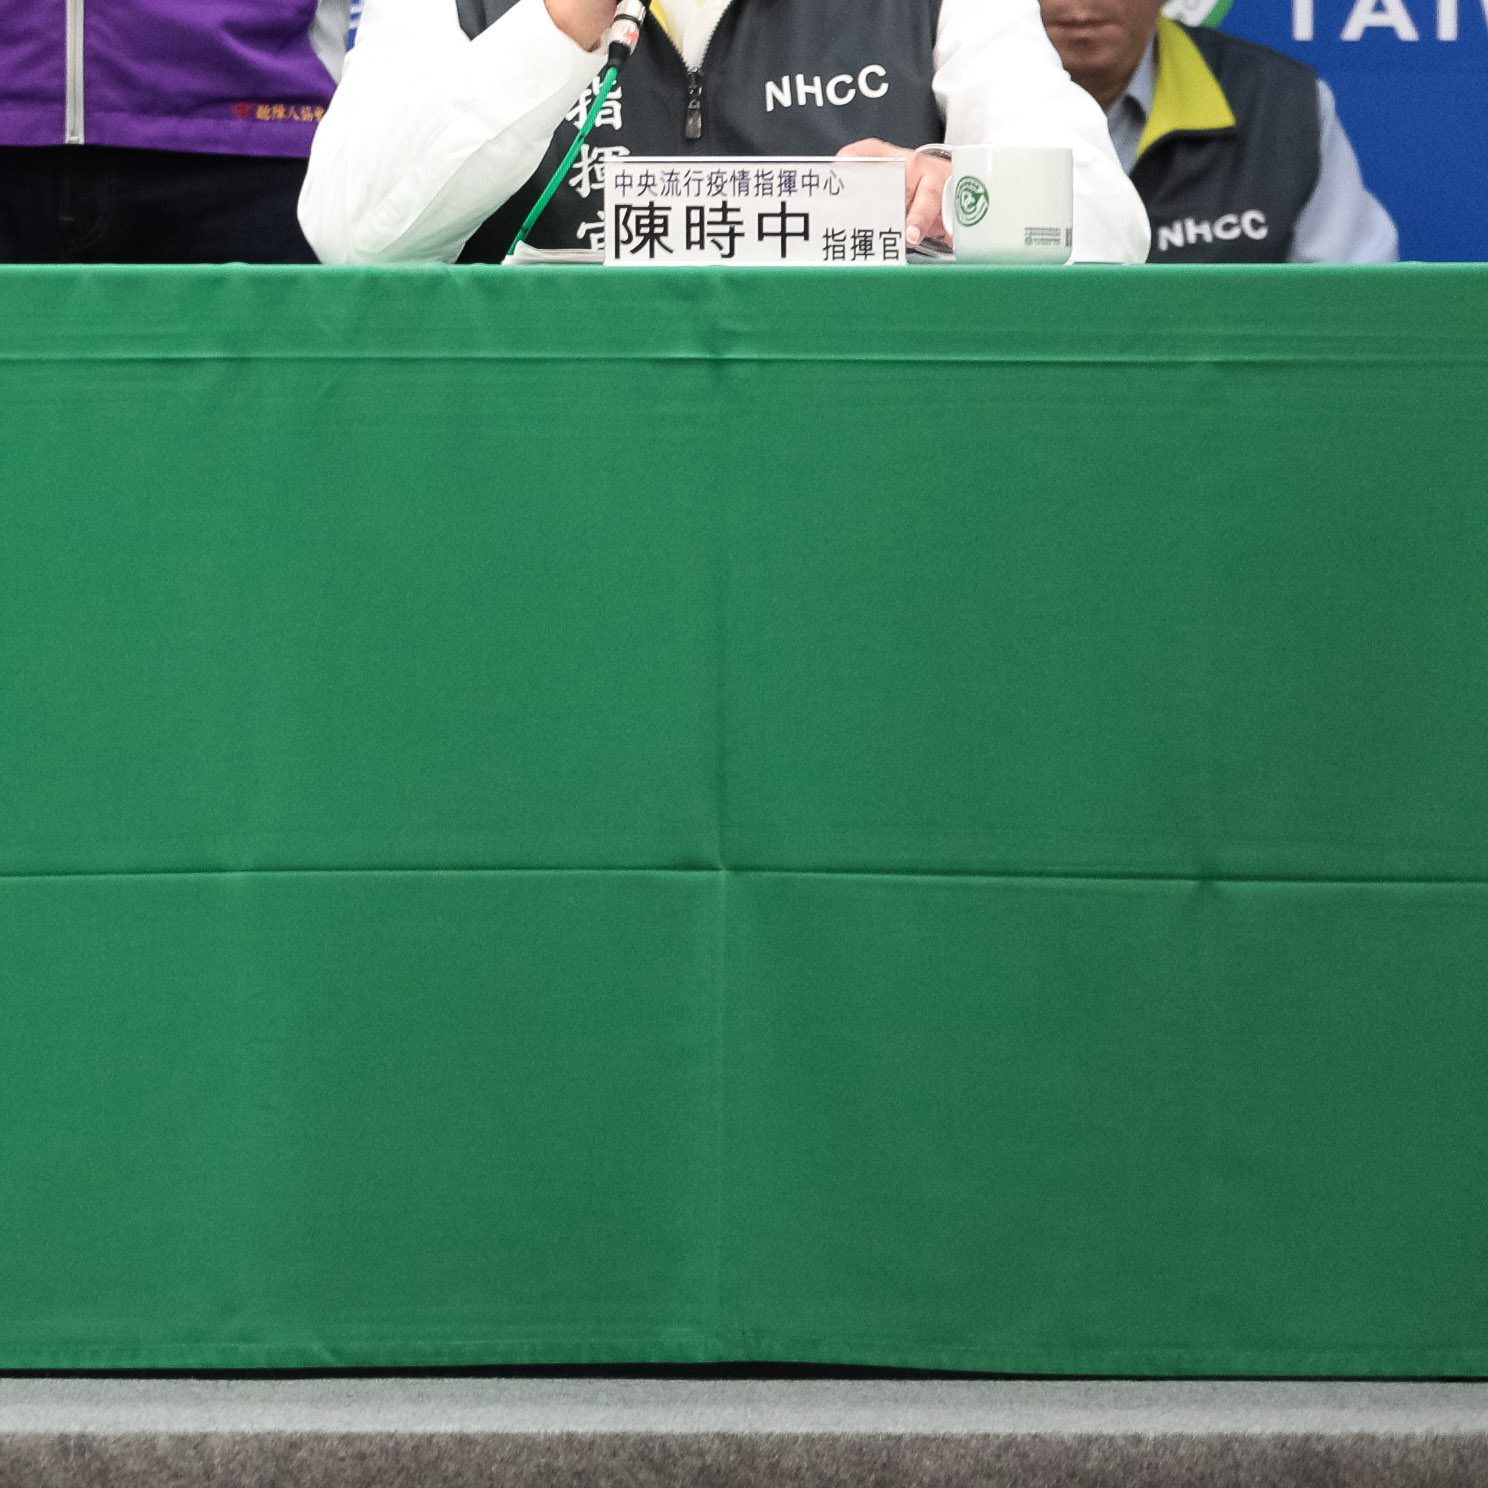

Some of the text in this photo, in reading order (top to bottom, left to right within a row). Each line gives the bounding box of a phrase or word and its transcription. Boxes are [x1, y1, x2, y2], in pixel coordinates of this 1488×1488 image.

[765, 64, 890, 112] NHCC
[614, 168, 846, 198] 中央流行疫情指揮中心
[614, 200, 903, 262] 陳時中 指揮官
[1157, 209, 1269, 252] NHCC
